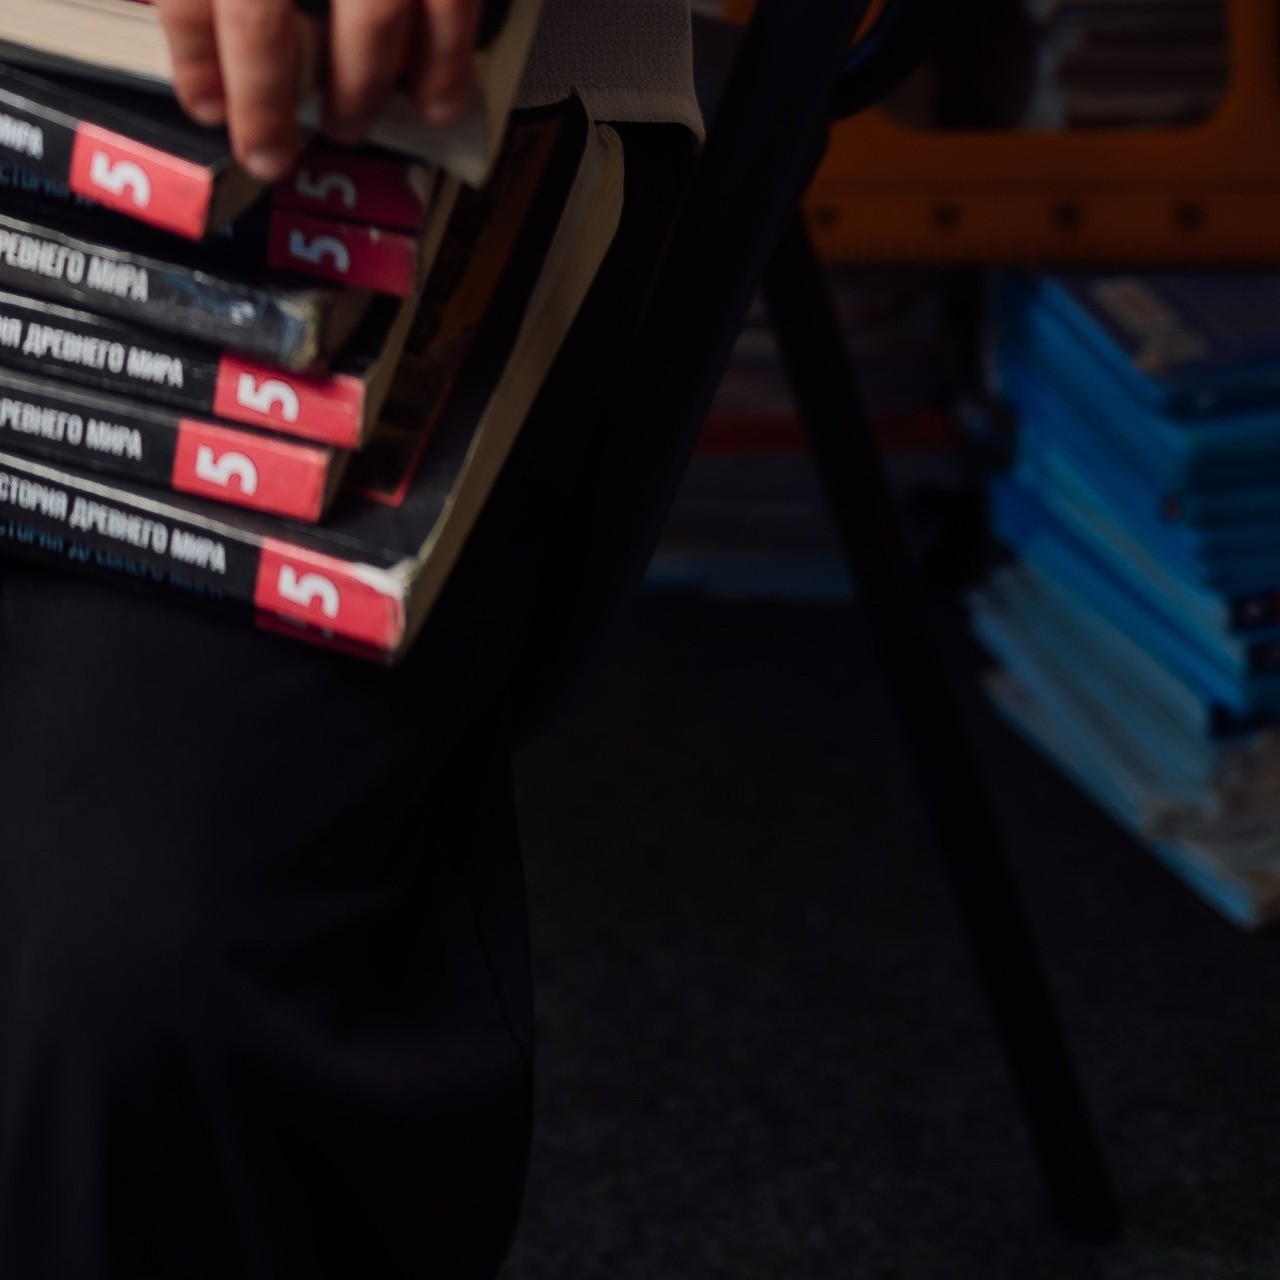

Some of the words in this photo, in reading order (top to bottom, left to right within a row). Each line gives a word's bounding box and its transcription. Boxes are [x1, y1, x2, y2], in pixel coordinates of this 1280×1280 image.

[89, 149, 152, 209] 5
[297, 168, 357, 210] 5
[288, 228, 351, 275] 5
[86, 255, 149, 304] МИРА
[22, 322, 126, 374] ДРЕВНЕГО
[126, 346, 184, 388] МИРА
[236, 372, 300, 423] 5
[85, 418, 143, 461] МИРА
[195, 444, 258, 496] 5
[69, 495, 169, 554] ДРЕВНЕГО
[170, 527, 226, 574] МИРА
[276, 563, 340, 619] 5
